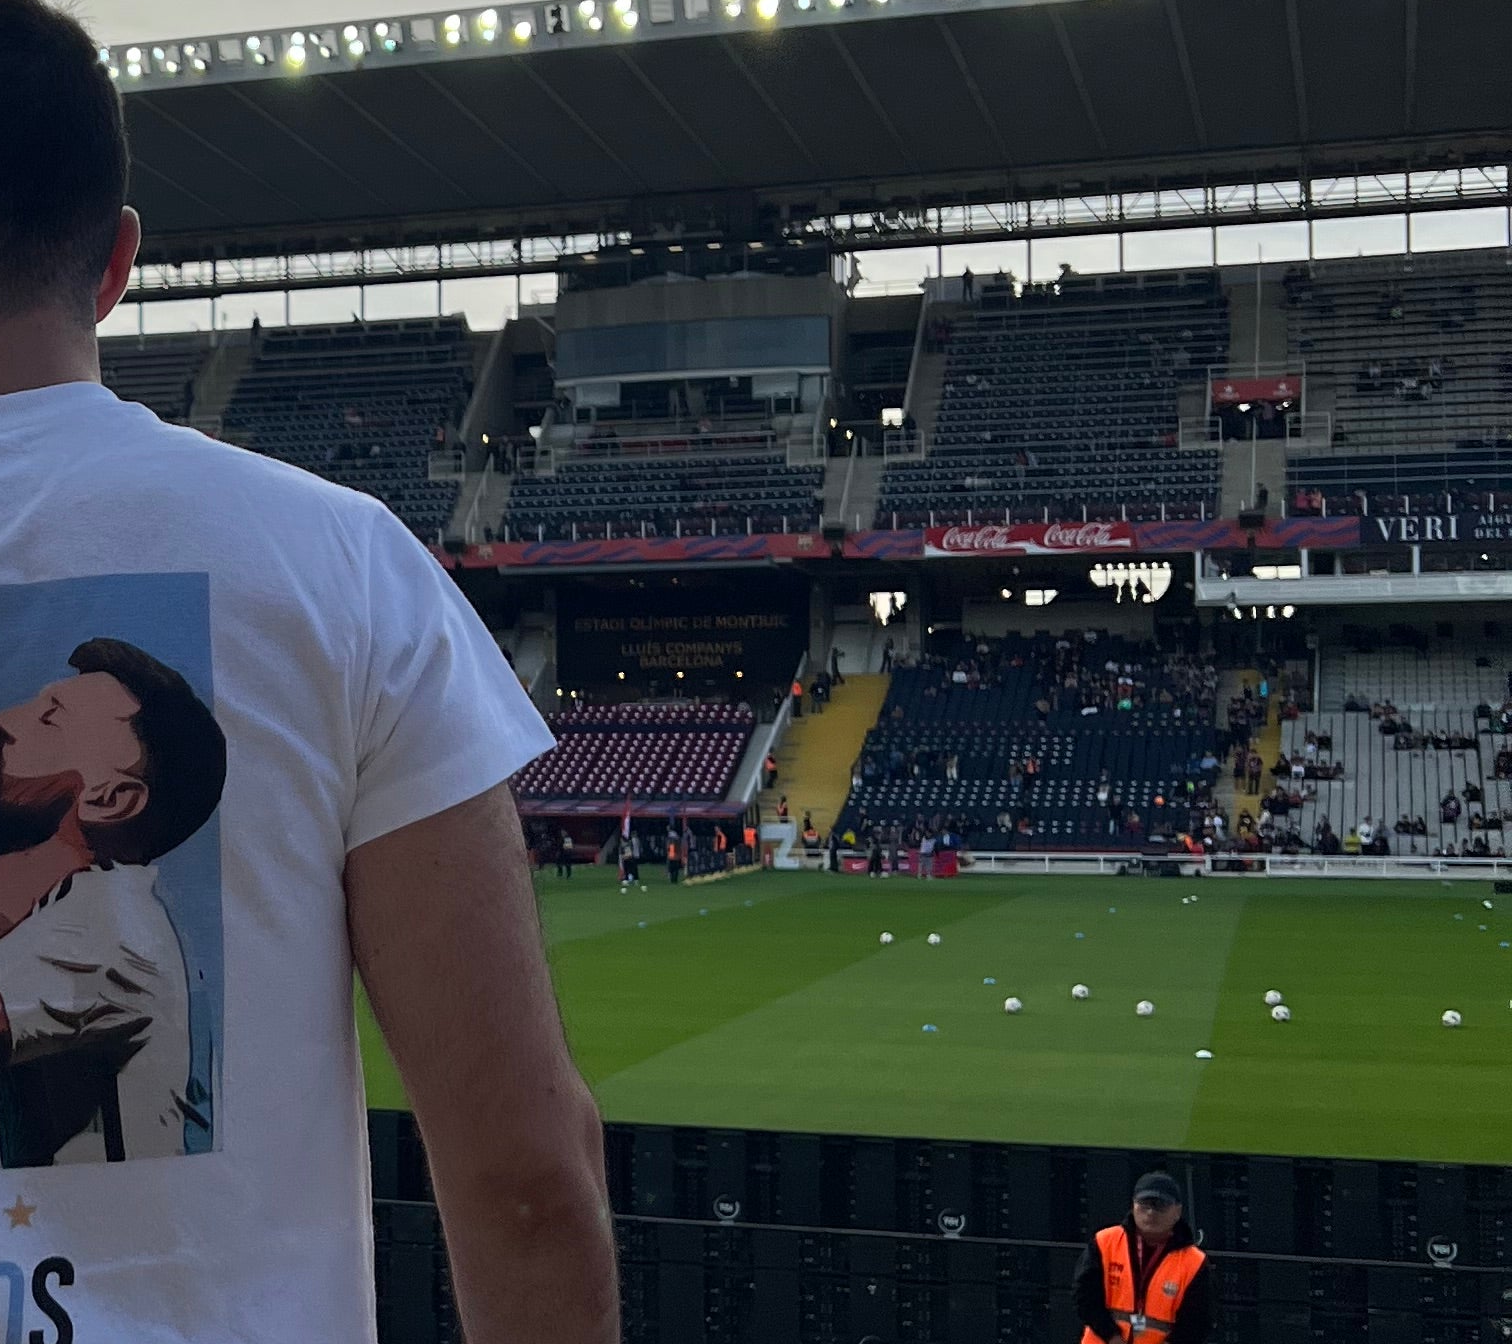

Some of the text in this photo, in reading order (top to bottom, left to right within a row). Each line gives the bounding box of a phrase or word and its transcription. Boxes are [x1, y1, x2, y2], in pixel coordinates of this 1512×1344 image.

[942, 524, 1011, 550] Coca-Cola
[1044, 521, 1113, 548] Coca-Cola
[692, 615, 712, 629] DE
[665, 640, 743, 656] COMPANYS
[639, 656, 724, 669] BARCELONA
